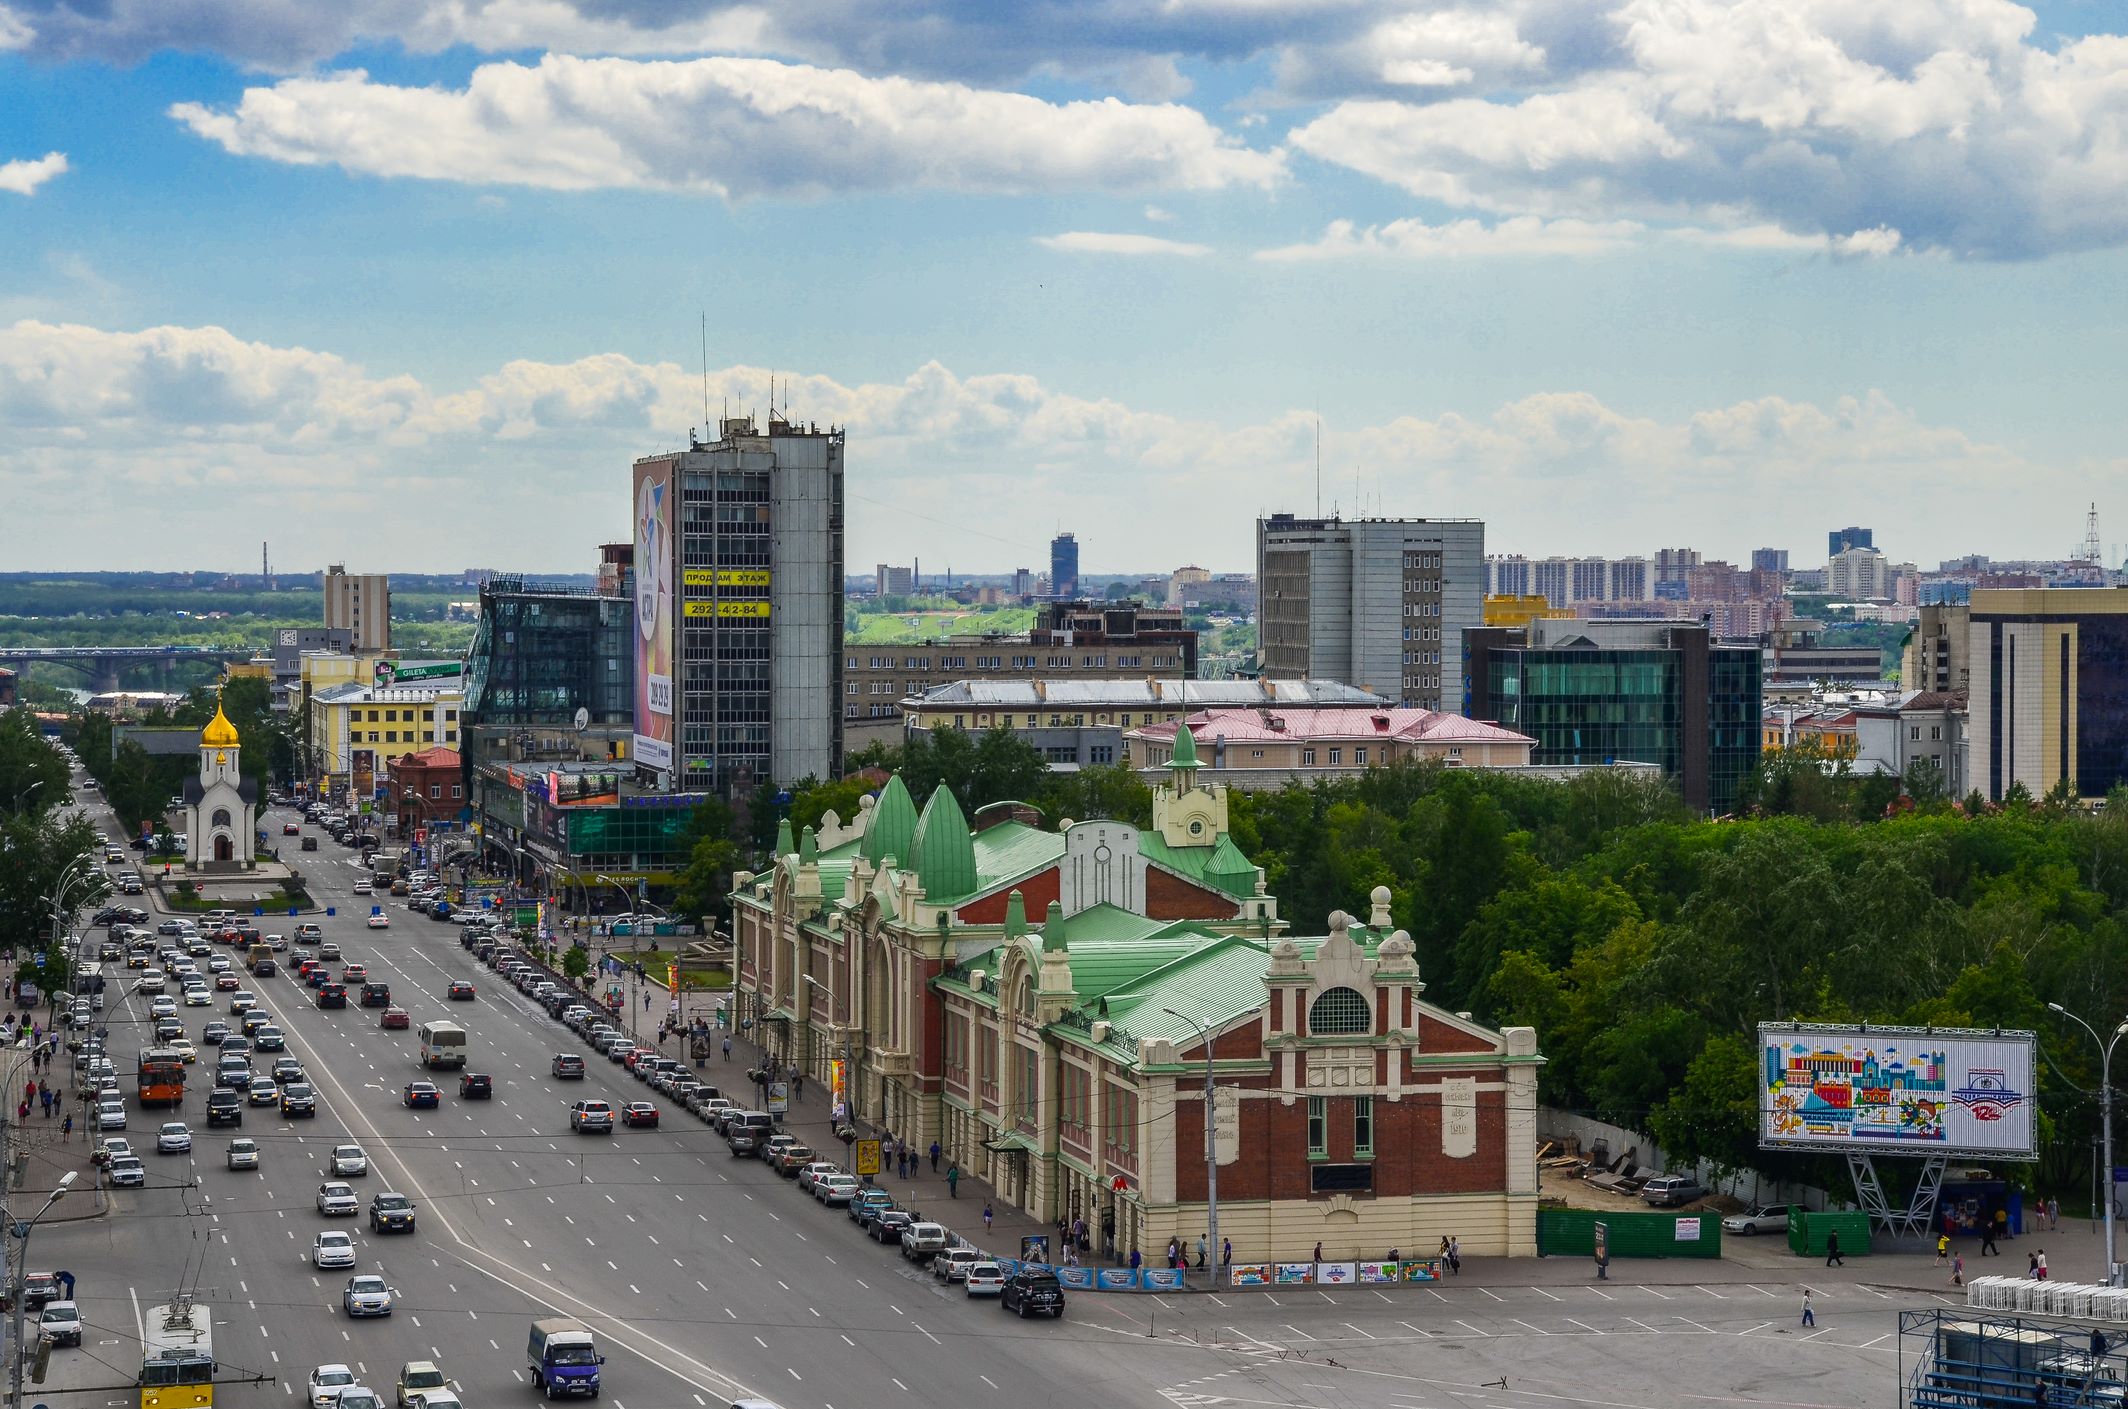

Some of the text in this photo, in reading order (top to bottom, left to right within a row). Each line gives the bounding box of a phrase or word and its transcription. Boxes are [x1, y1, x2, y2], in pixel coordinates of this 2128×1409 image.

[686, 574, 766, 582] ПРОДАМ ЭТАЖ
[691, 605, 757, 614] 292-42-84
